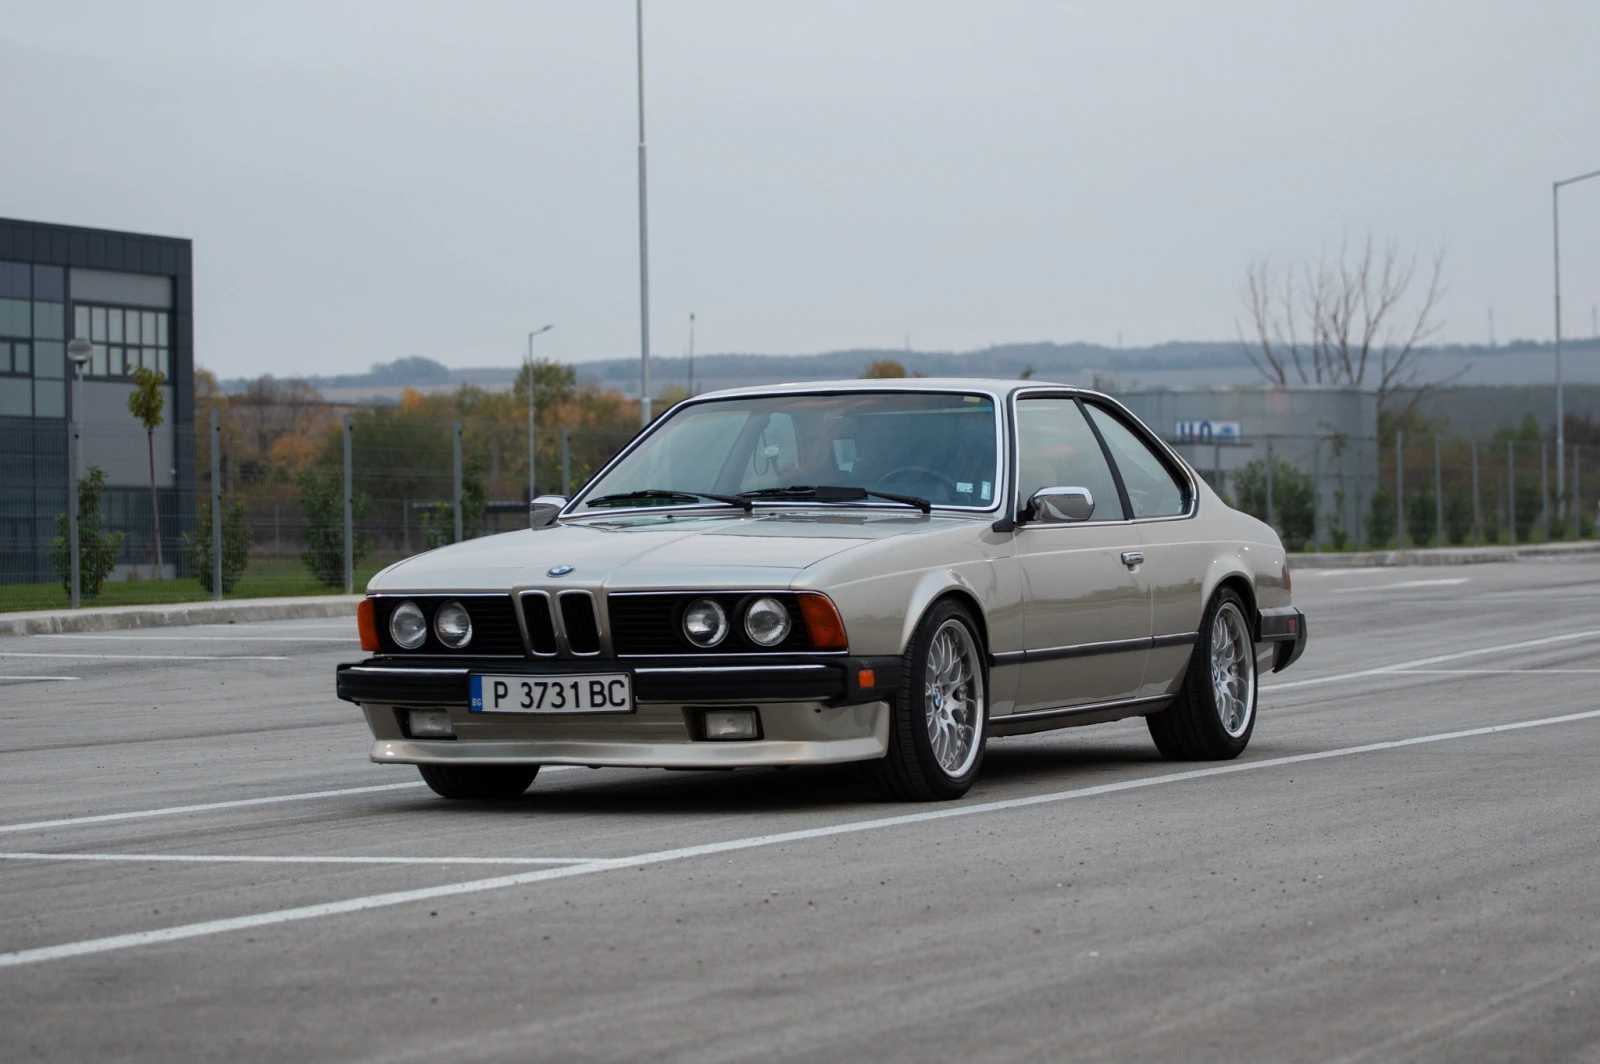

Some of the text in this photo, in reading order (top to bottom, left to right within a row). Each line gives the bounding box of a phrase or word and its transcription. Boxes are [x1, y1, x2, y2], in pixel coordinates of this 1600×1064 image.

[472, 698, 482, 706] BG
[494, 680, 626, 709] P 3731 BC
